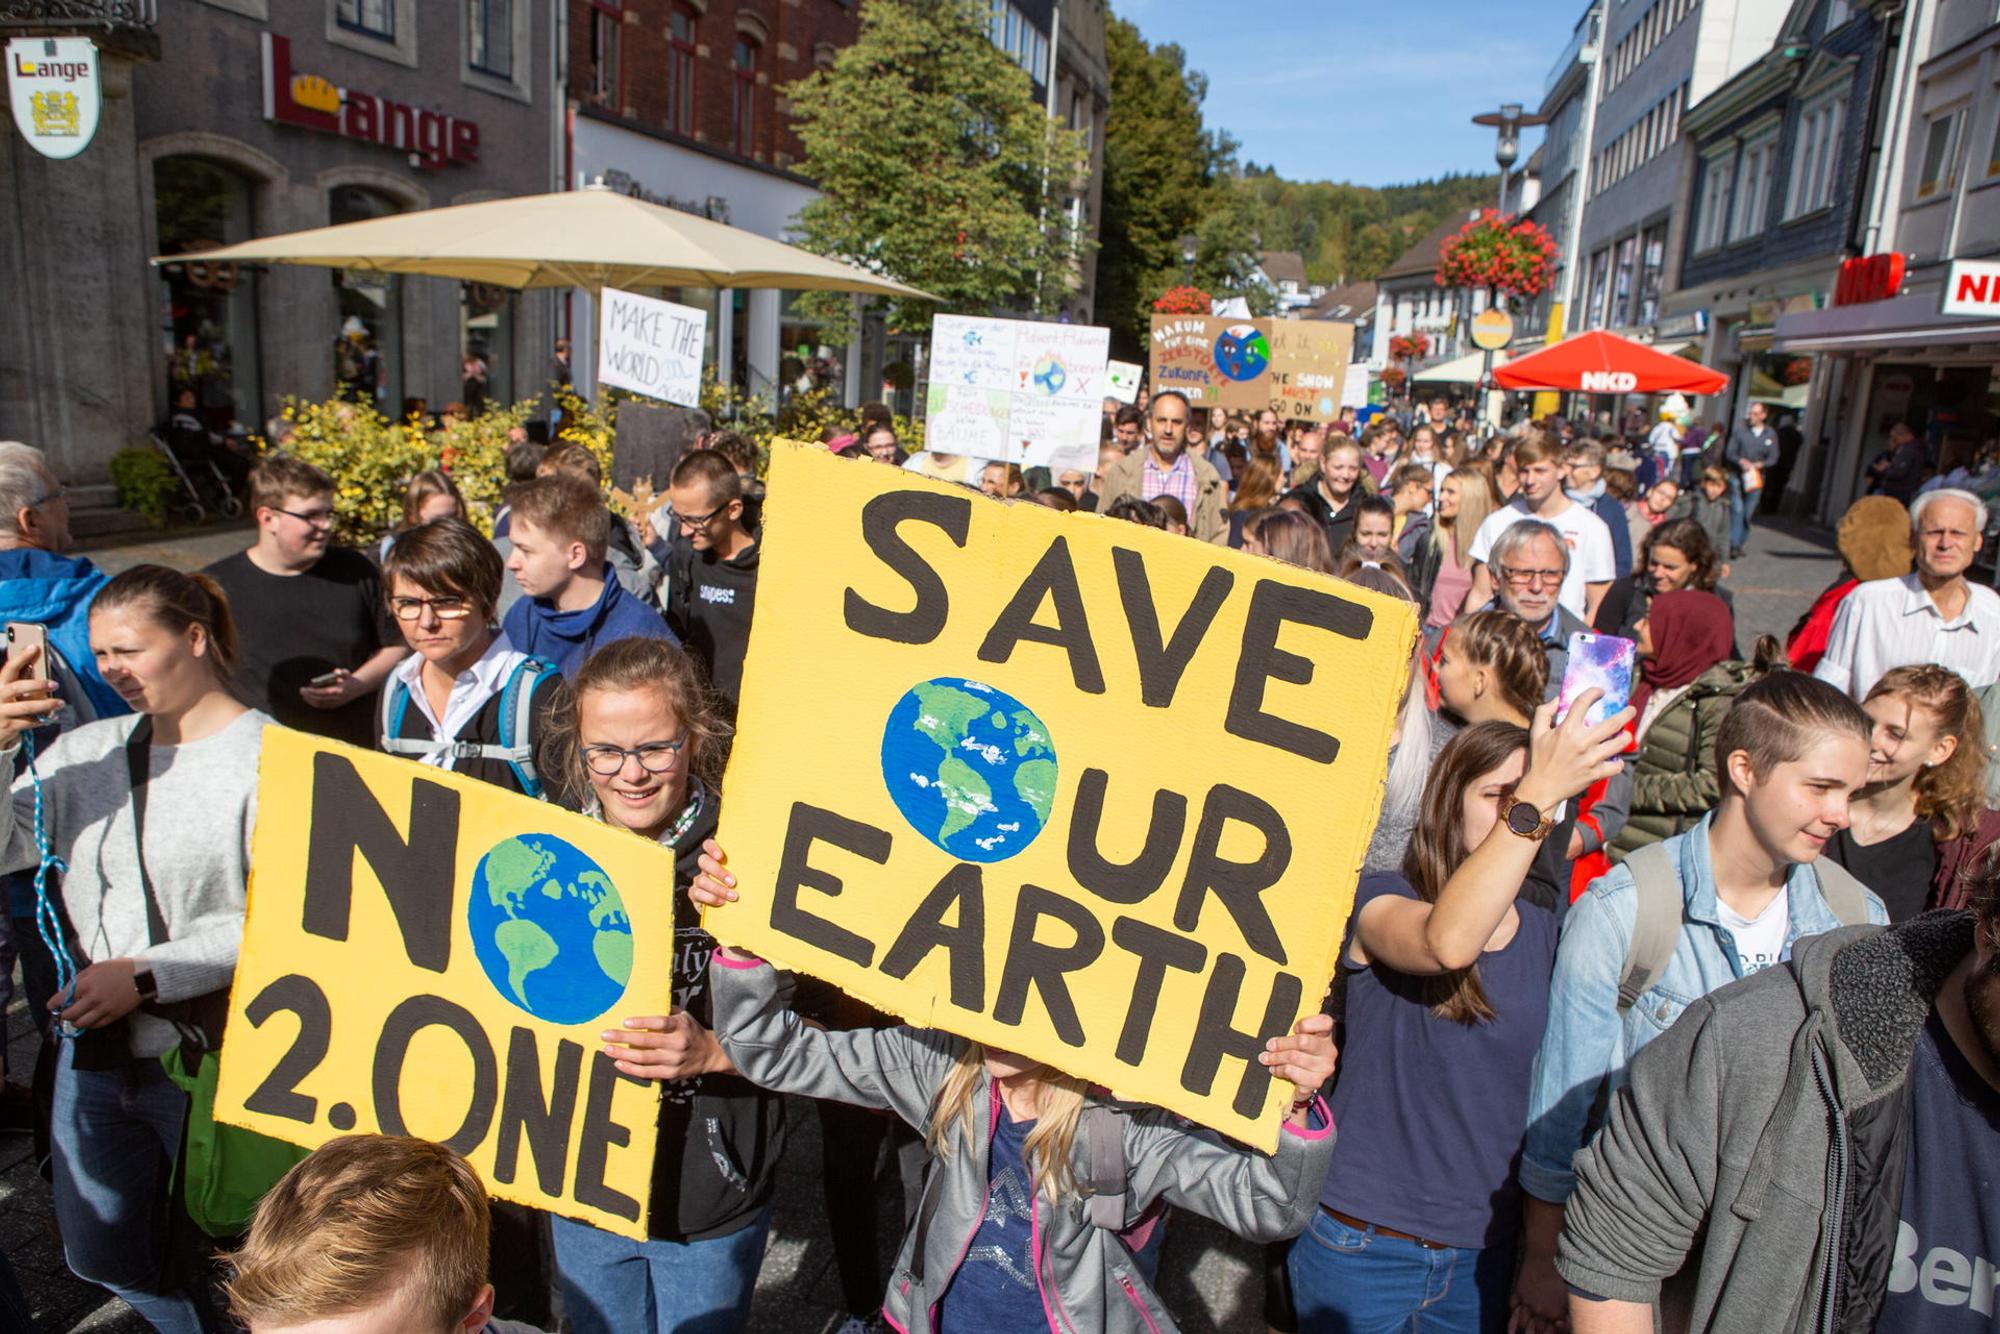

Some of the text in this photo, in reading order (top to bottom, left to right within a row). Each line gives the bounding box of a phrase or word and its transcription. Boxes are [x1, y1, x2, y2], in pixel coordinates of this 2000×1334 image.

[14, 53, 89, 82] Lange
[262, 31, 480, 169] Lange
[609, 299, 702, 359] MAKE THE
[605, 338, 660, 386] WORLD
[1581, 371, 1637, 391] NKD
[1282, 386, 1319, 401] MUST
[1295, 401, 1312, 416] ON
[843, 490, 1375, 765] SAVE
[769, 800, 1303, 1121] EARTH
